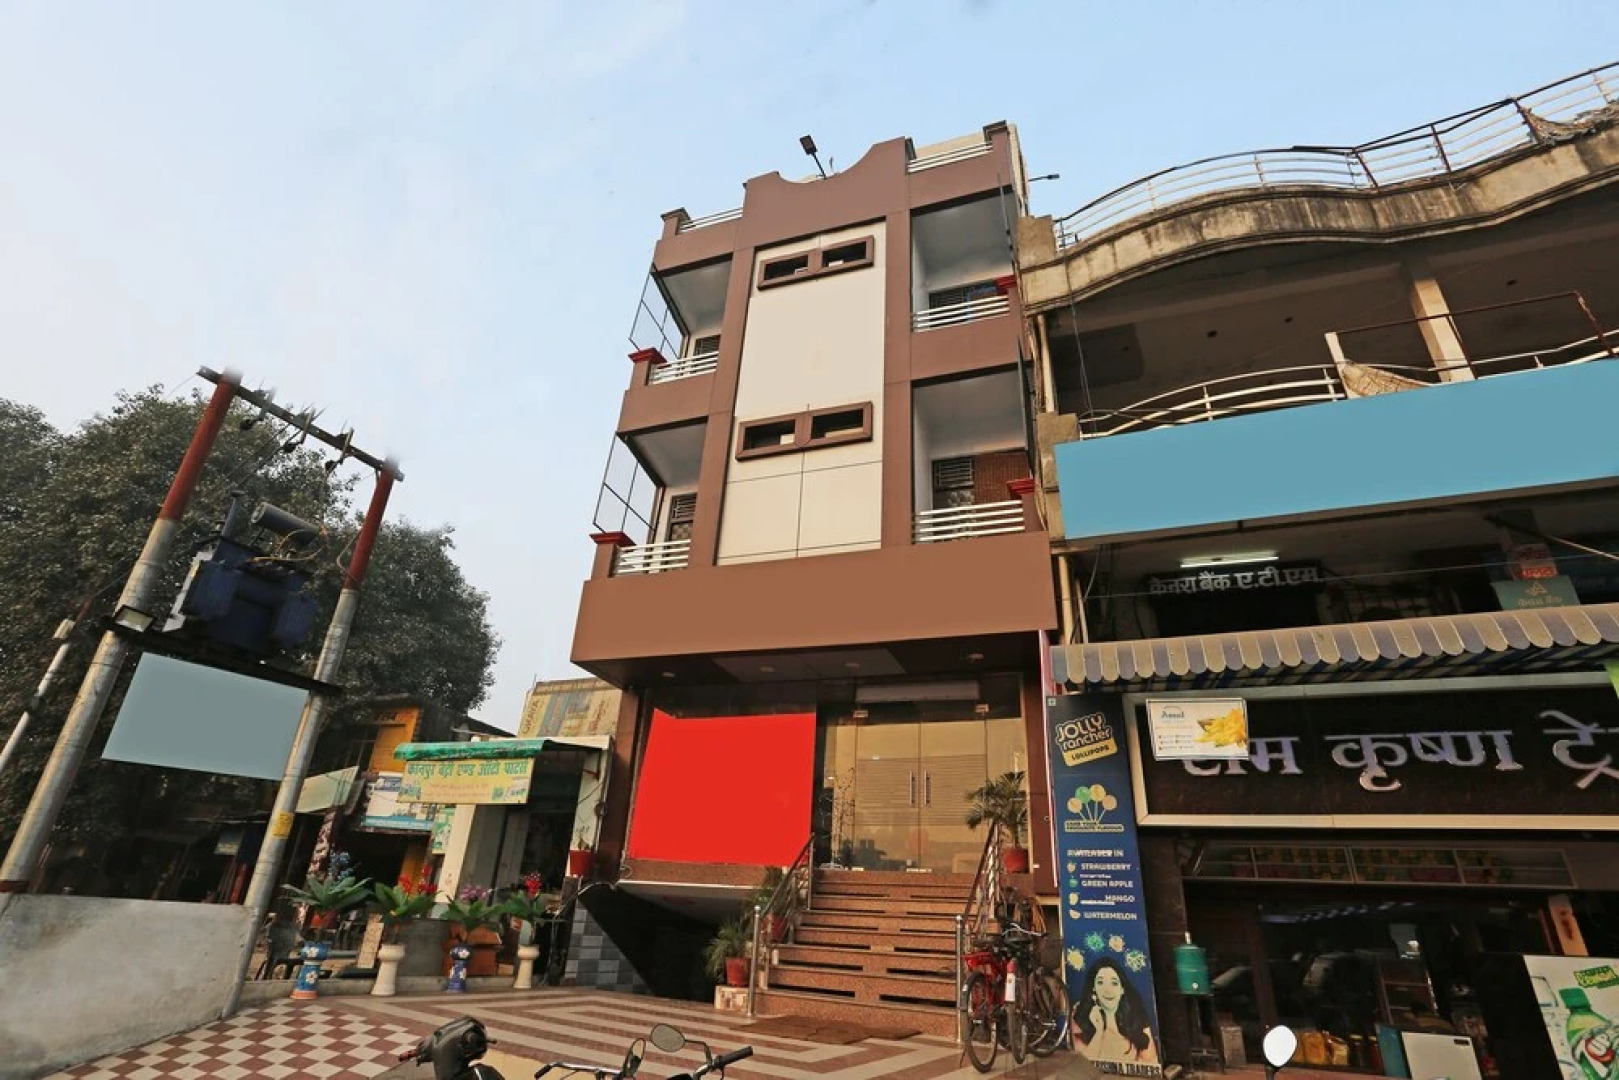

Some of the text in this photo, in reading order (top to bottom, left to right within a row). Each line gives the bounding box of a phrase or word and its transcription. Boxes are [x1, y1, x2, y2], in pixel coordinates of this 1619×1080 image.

[1200, 570, 1231, 592] बैंक
[1058, 714, 1104, 742] JOLLY
[1062, 729, 1111, 750] rancher
[1322, 730, 1524, 792] कृष्ण
[1539, 709, 1619, 790] ट्रे
[407, 763, 436, 779] कानपुर
[1081, 863, 1131, 871] STRAWBERRY
[1081, 880, 1134, 888] GREEN APPLE
[1105, 894, 1135, 903] MANGO
[1083, 912, 1137, 921] WATERMELON
